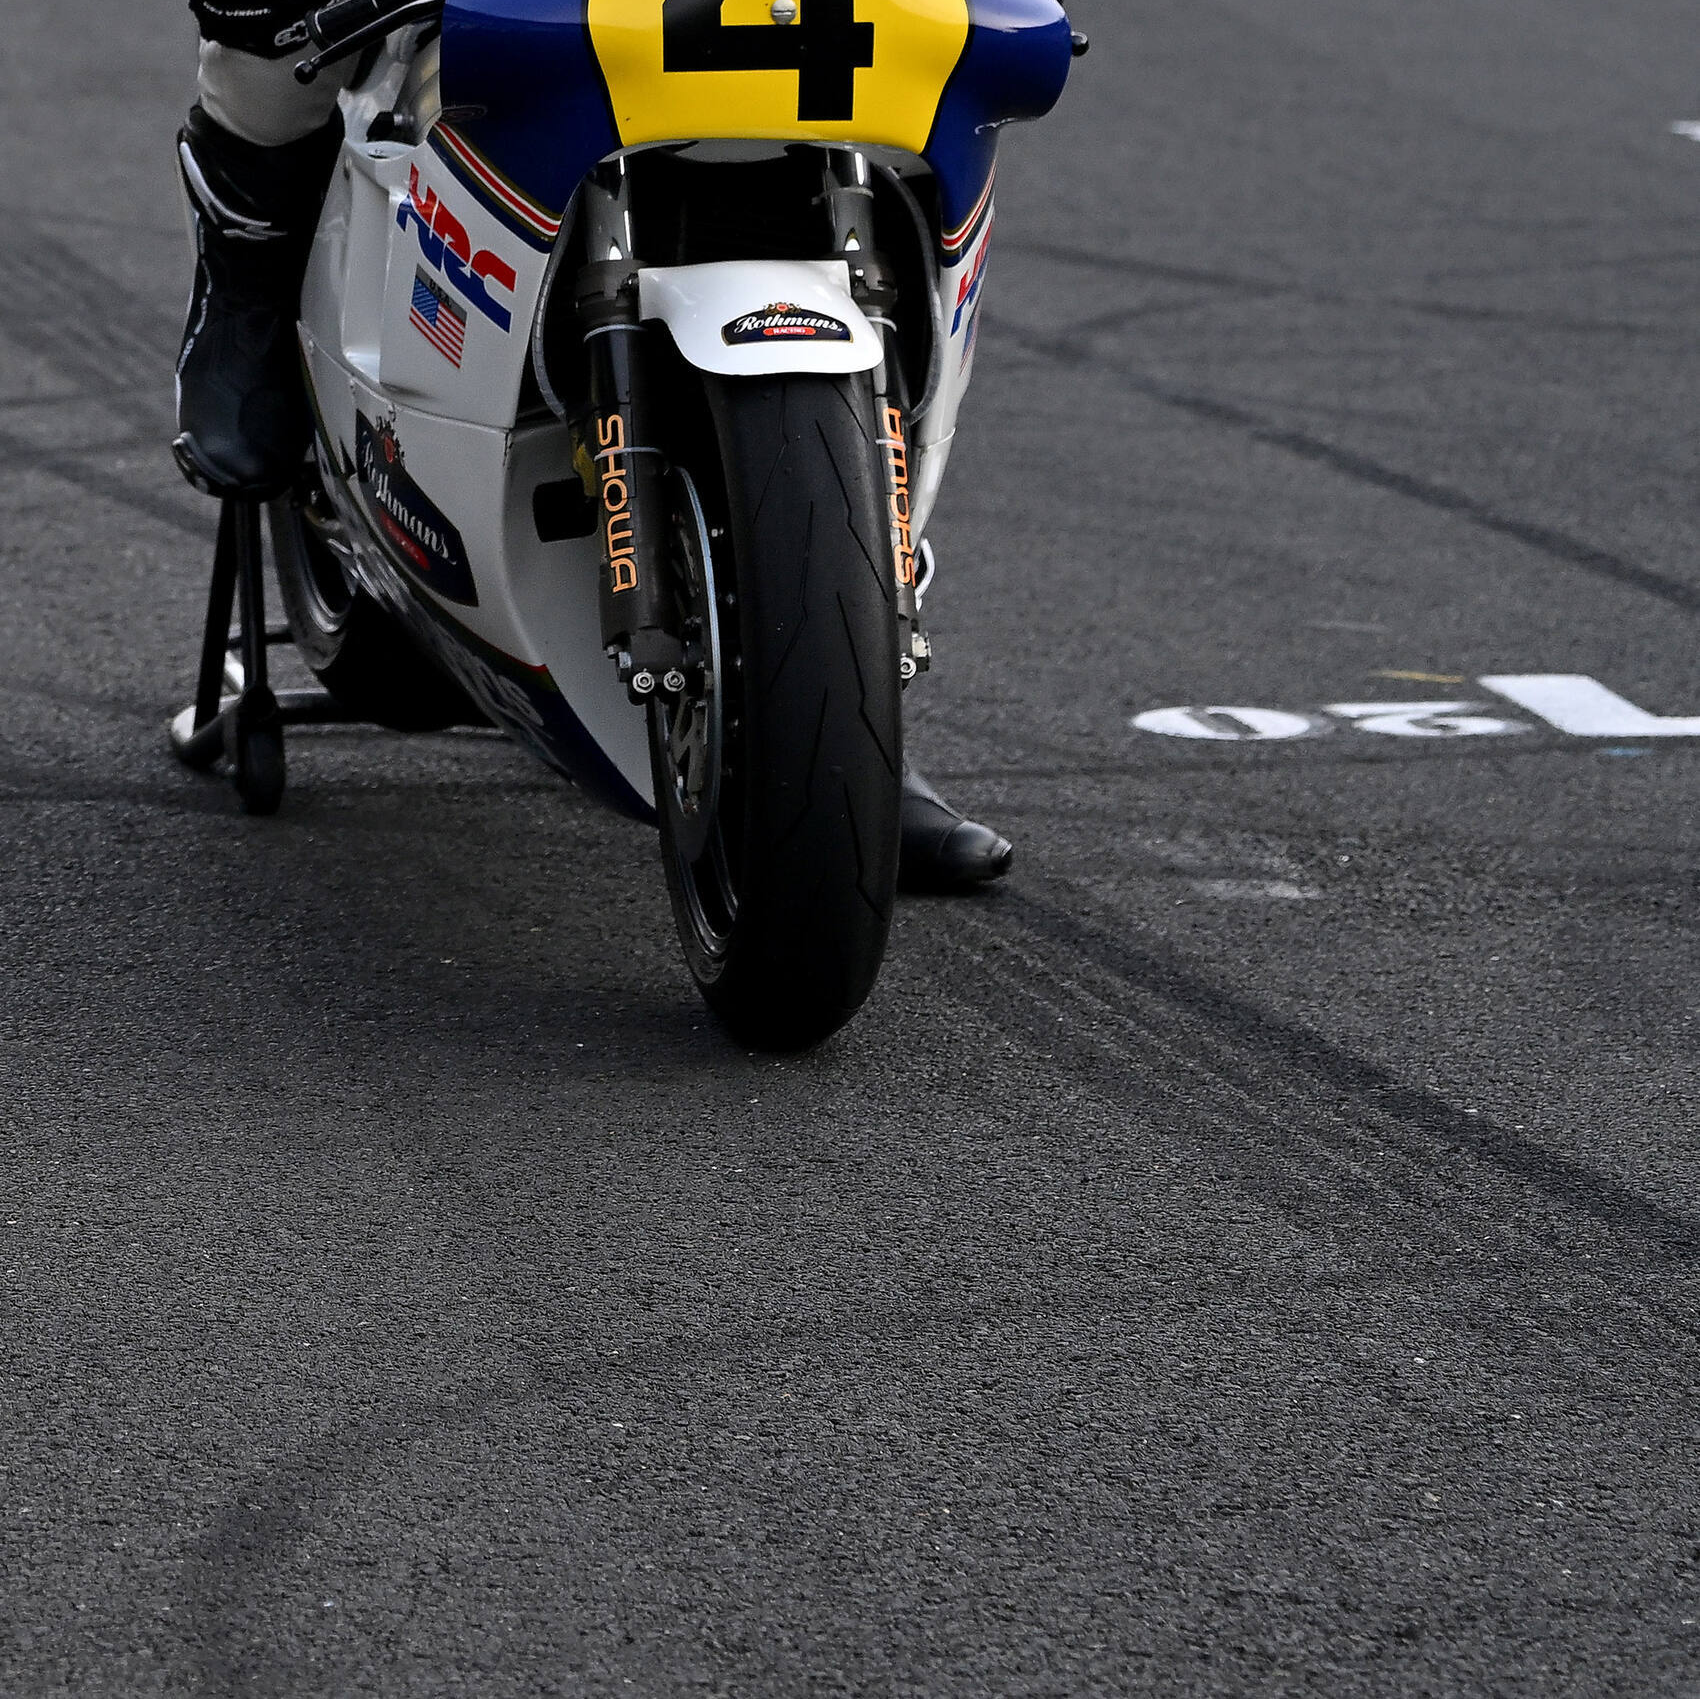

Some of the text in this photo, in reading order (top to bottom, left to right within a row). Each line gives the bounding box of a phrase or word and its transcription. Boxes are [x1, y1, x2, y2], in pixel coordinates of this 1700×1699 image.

[395, 161, 518, 334] HRC
[733, 313, 844, 334] Rothmans
[596, 413, 639, 594] SHOWA
[882, 407, 917, 588] SHOWA
